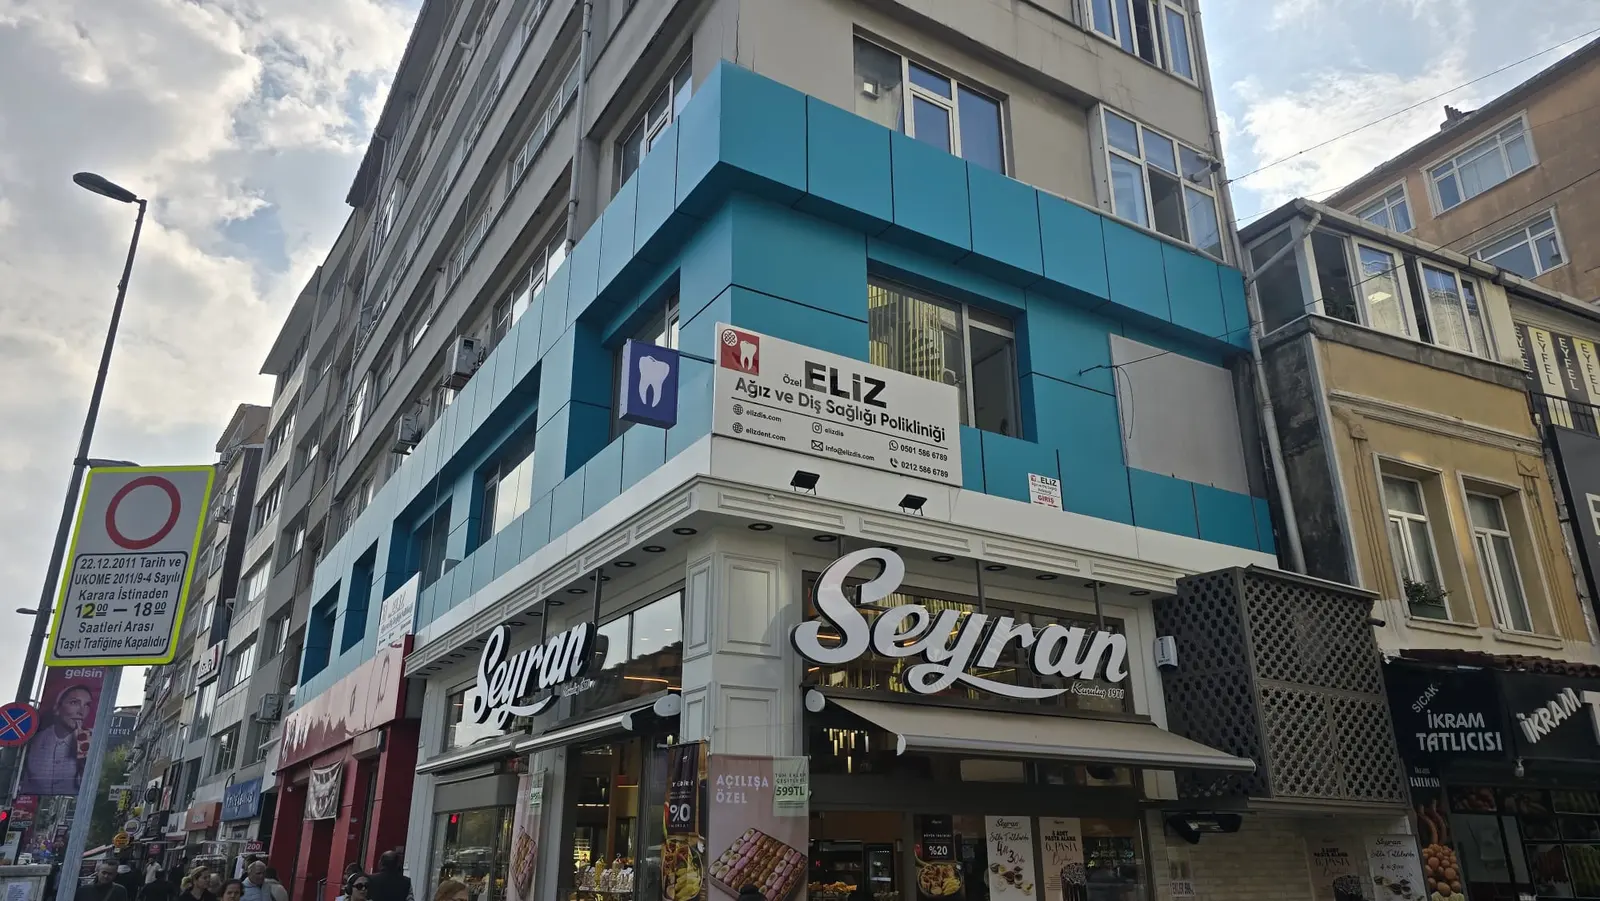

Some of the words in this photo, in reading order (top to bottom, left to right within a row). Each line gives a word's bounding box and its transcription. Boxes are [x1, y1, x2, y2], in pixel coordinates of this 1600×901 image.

[1536, 331, 1556, 386] EYFEL
[1558, 337, 1580, 391] EYFEL
[1580, 343, 1600, 396] EYFEL
[782, 374, 802, 387] Özel
[735, 377, 770, 398] Ağız
[775, 390, 794, 404] ve
[798, 392, 822, 414] Diş
[826, 399, 876, 426] Sağlığı
[880, 413, 946, 442] Polikliniği
[746, 408, 782, 422] elizdis.com
[745, 428, 786, 442] elizdent.com
[824, 428, 844, 436] elizdis
[900, 444, 916, 455] 0501
[918, 448, 930, 458] 586
[931, 450, 948, 462] 6789
[901, 461, 918, 472] 0212
[919, 465, 932, 475] 586
[932, 468, 948, 478] 6789
[80, 558, 136, 570] 22.12.2011
[140, 556, 166, 568] Tarih
[169, 558, 182, 568] ve
[74, 574, 110, 585] UKOME
[112, 573, 152, 584] 2011/9-4
[154, 572, 180, 585] Sayılı
[78, 590, 114, 600] Karara
[118, 586, 168, 600] İstinaden
[78, 621, 122, 633] Saatleri
[124, 621, 154, 632] Arası
[792, 547, 1128, 699] Seyran
[60, 638, 81, 650] Taşıt
[84, 637, 122, 651] Trafiğine
[124, 636, 166, 650] Kapalıdır
[65, 668, 102, 679] gelsin
[474, 622, 596, 730] Seyran
[1412, 684, 1440, 713] SICAK
[1427, 710, 1485, 729] İKRAM
[1516, 688, 1582, 744] İKRAM
[1416, 732, 1503, 752] TATLICISI
[716, 774, 768, 790] AÇILIŞA
[716, 789, 748, 804] ÖZEL
[776, 786, 804, 796] 599TL
[928, 845, 948, 856] %20
